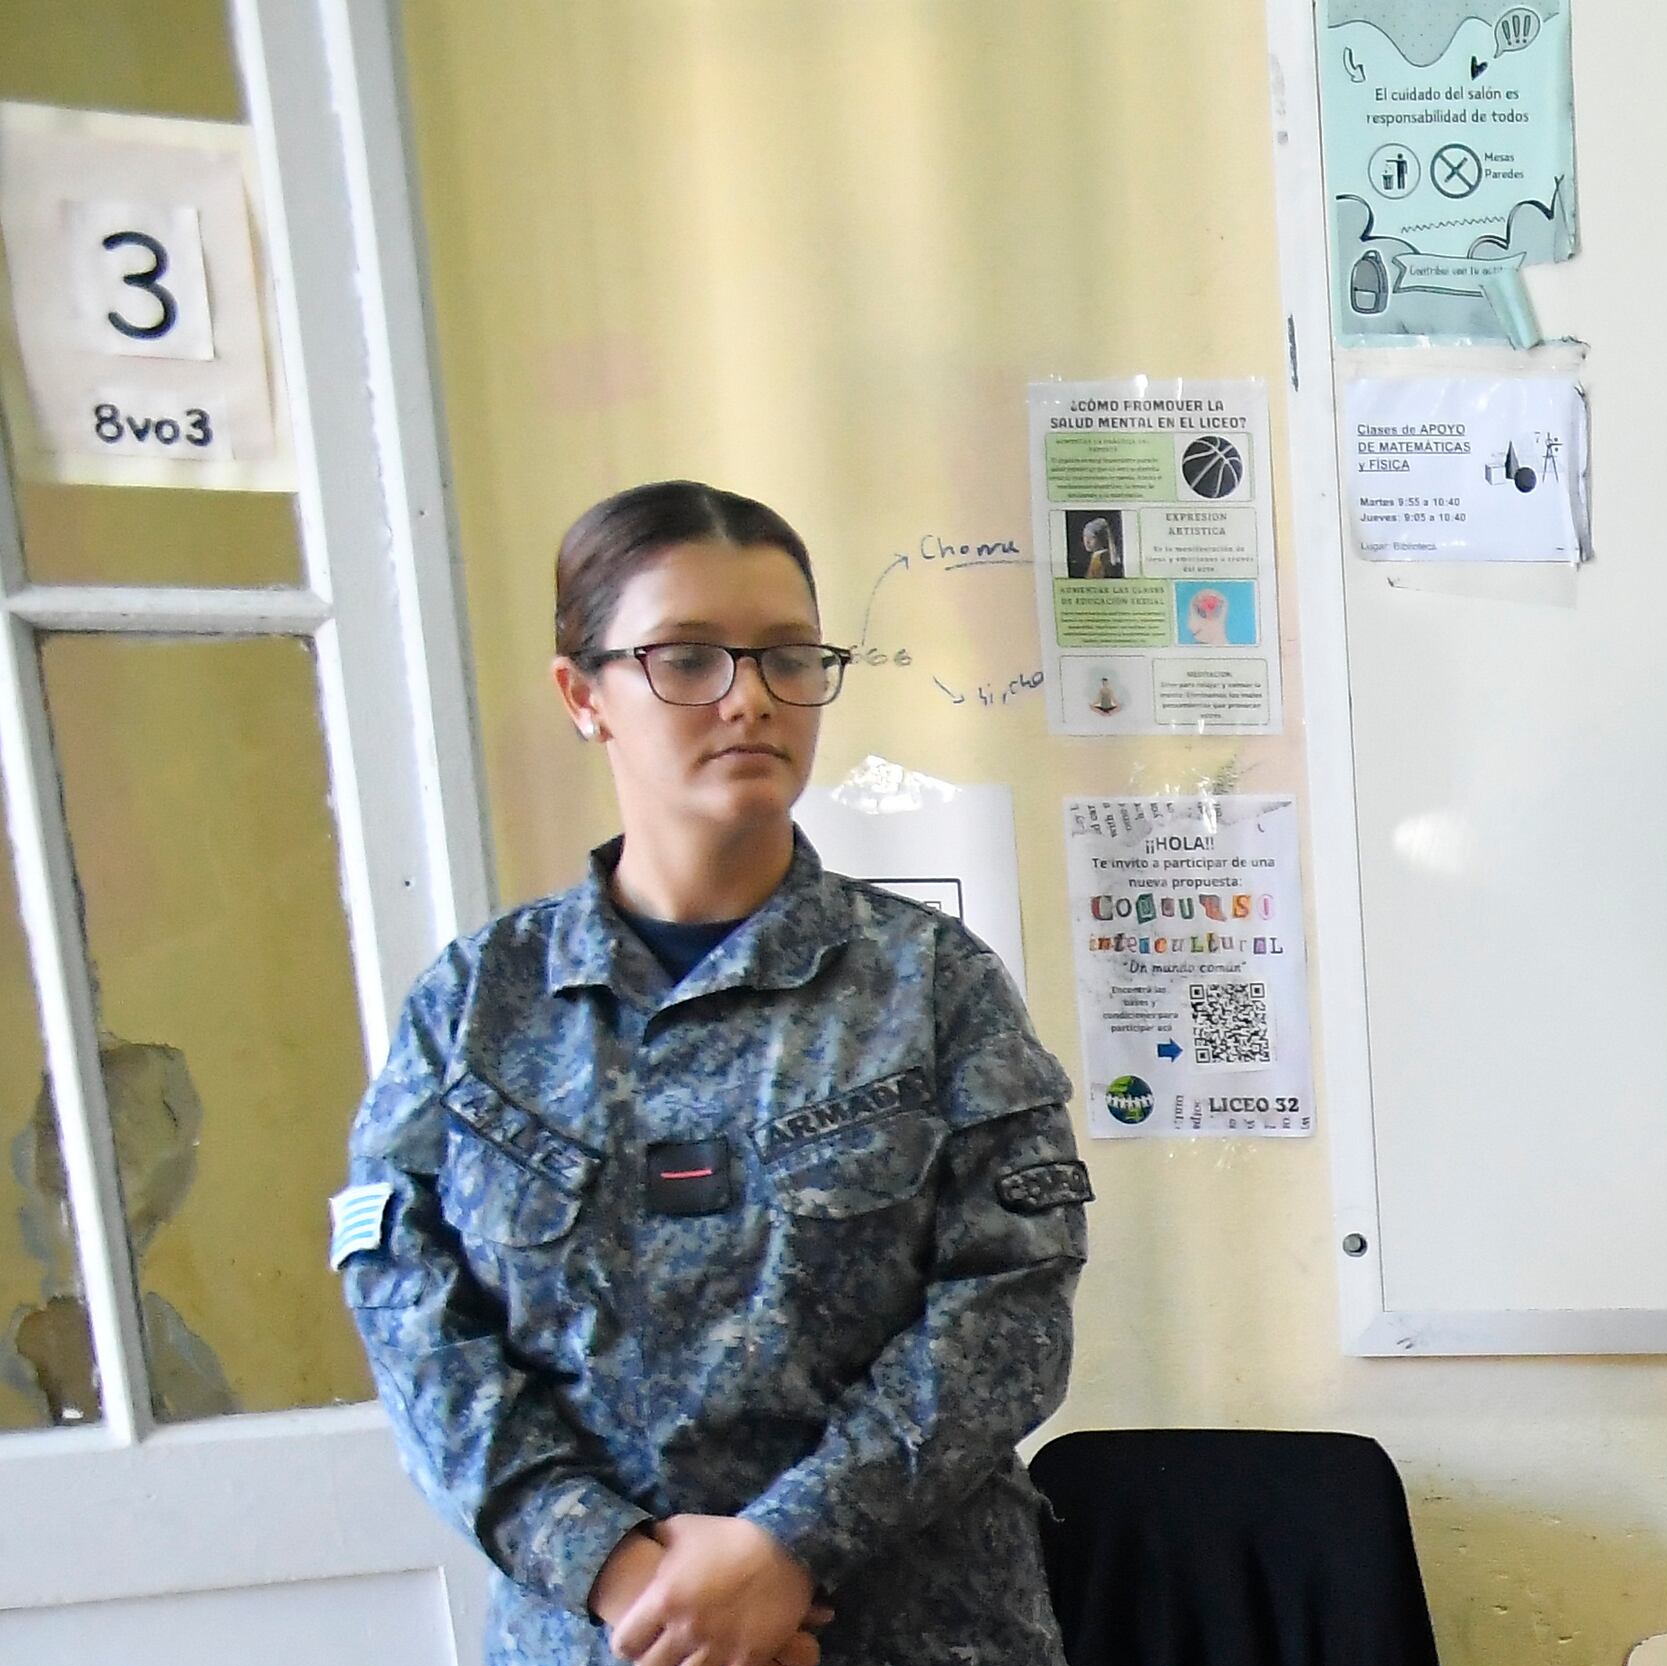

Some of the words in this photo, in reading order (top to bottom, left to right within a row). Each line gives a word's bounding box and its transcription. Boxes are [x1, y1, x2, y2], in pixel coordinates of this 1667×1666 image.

[1375, 87, 1387, 101] El
[1391, 87, 1441, 101] cuidado
[1444, 86, 1464, 100] del
[1467, 85, 1502, 100] salón
[1505, 90, 1520, 100] es
[1366, 108, 1467, 127] responsabilidad
[1471, 108, 1487, 123] de
[1492, 108, 1529, 123] todos
[1484, 152, 1515, 162] Mesas
[1484, 168, 1525, 179] Paredes
[102, 231, 178, 340] 3
[1123, 400, 1203, 412] PROMOVER
[1207, 400, 1225, 412] LA
[1050, 417, 1093, 429] SALUD
[1098, 417, 1153, 429] MENTAL
[1158, 417, 1175, 429] EN
[1180, 417, 1195, 429] EL
[1200, 417, 1247, 429] LICEO?
[1357, 424, 1398, 436] Clases
[1402, 424, 1416, 436] de
[1420, 424, 1466, 436] APOYO
[1358, 441, 1375, 453] DE
[1379, 440, 1471, 453] MATEMÁTICAS
[1358, 462, 1366, 472] y
[1368, 458, 1410, 471] FÍSICA
[1360, 497, 1394, 507] Martes
[1433, 497, 1461, 507] 10:40
[1404, 513, 1426, 522] 9:05
[1439, 513, 1466, 522] 10:40
[1145, 836, 1215, 855] ¡¡HOLA!!
[1091, 857, 1107, 869] Te
[1111, 857, 1149, 869] invito
[1152, 860, 1159, 868] a
[1163, 857, 1227, 870] participar
[1231, 856, 1247, 867] de
[1251, 859, 1275, 868] una
[1128, 879, 1167, 888] nueva
[1172, 877, 1243, 889] propuesta:
[1208, 1097, 1270, 1113] LICEO
[1274, 1097, 1300, 1113] 32
